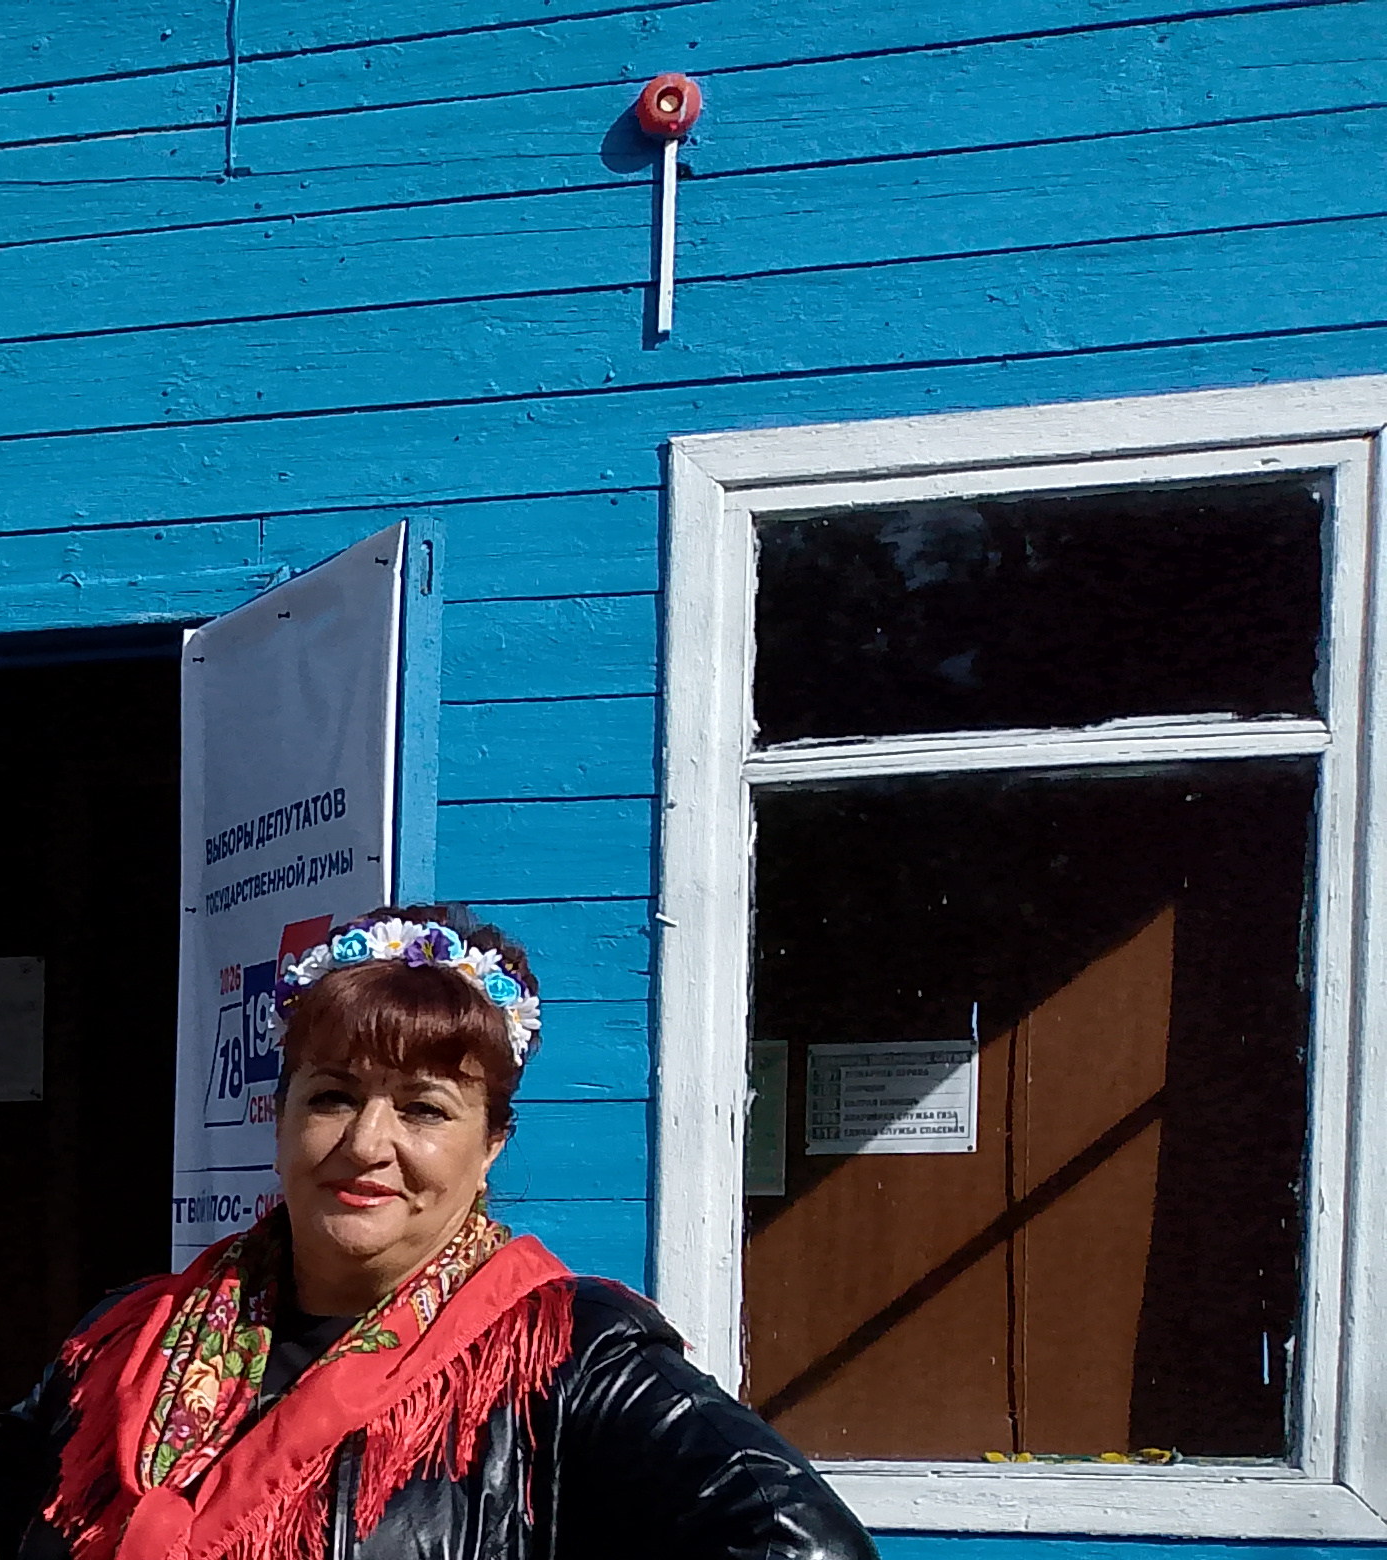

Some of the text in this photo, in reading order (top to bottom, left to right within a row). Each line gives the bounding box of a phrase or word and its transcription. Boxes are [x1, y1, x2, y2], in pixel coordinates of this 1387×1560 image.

[206, 788, 345, 865] ВЫБОРЫ ДЕПУТАТОВ
[206, 848, 353, 916] ГОСУДАРСТВЕННОЙ ДУМЫ
[246, 990, 275, 1059] 19
[218, 1037, 243, 1099] 18
